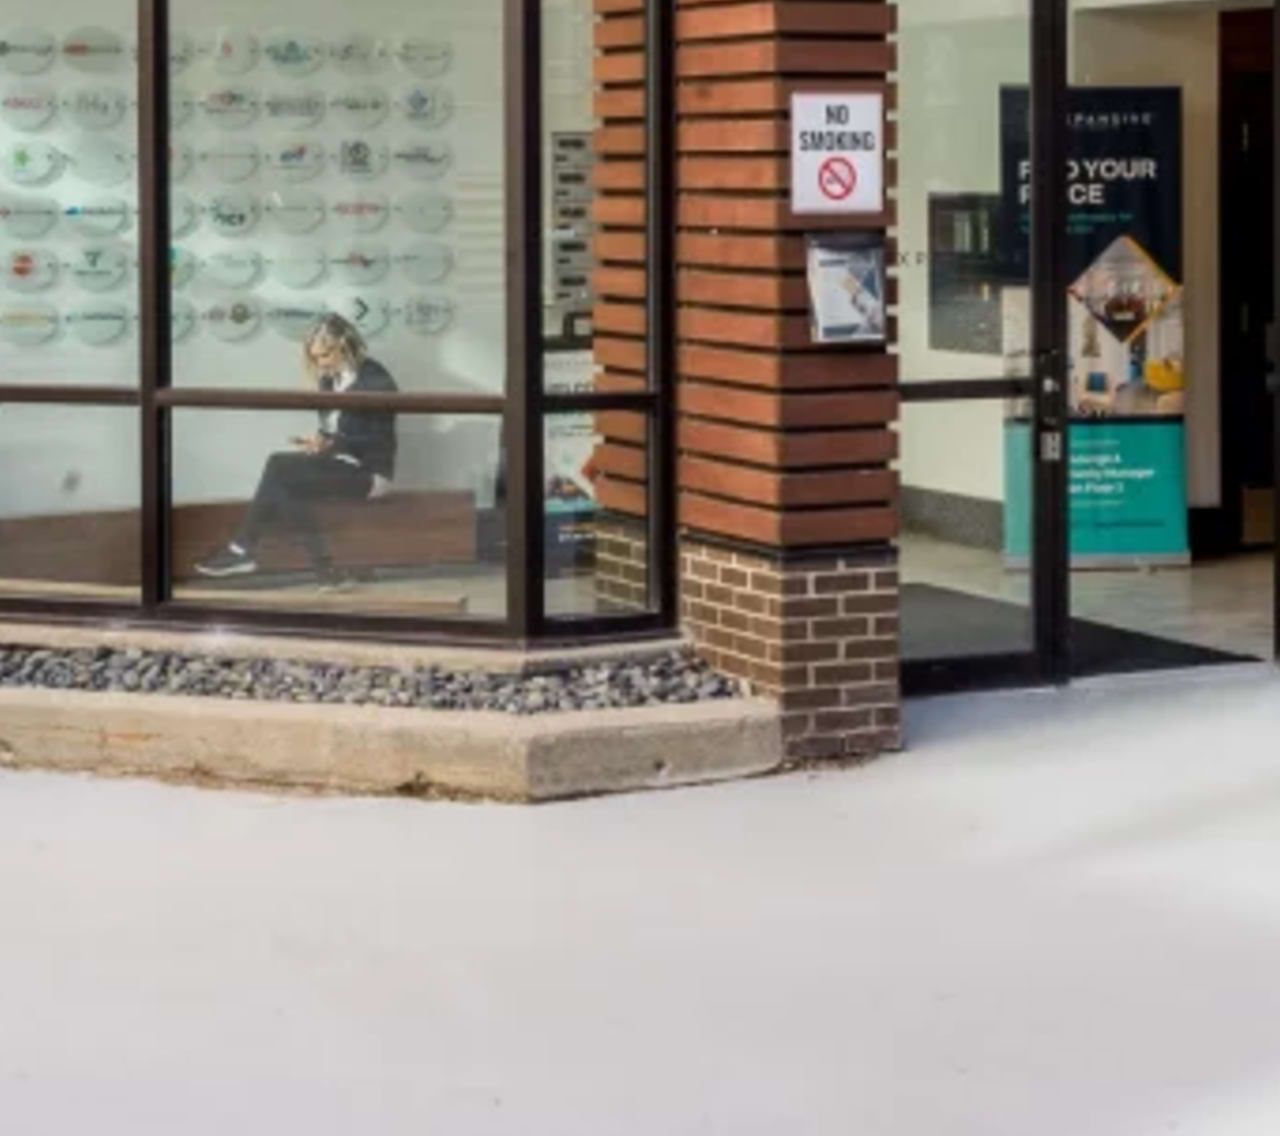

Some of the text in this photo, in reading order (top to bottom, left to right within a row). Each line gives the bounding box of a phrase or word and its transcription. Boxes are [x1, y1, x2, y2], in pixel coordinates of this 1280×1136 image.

[824, 104, 851, 126] NO
[798, 130, 876, 152] SMOKING
[1082, 157, 1158, 181] YOUR
